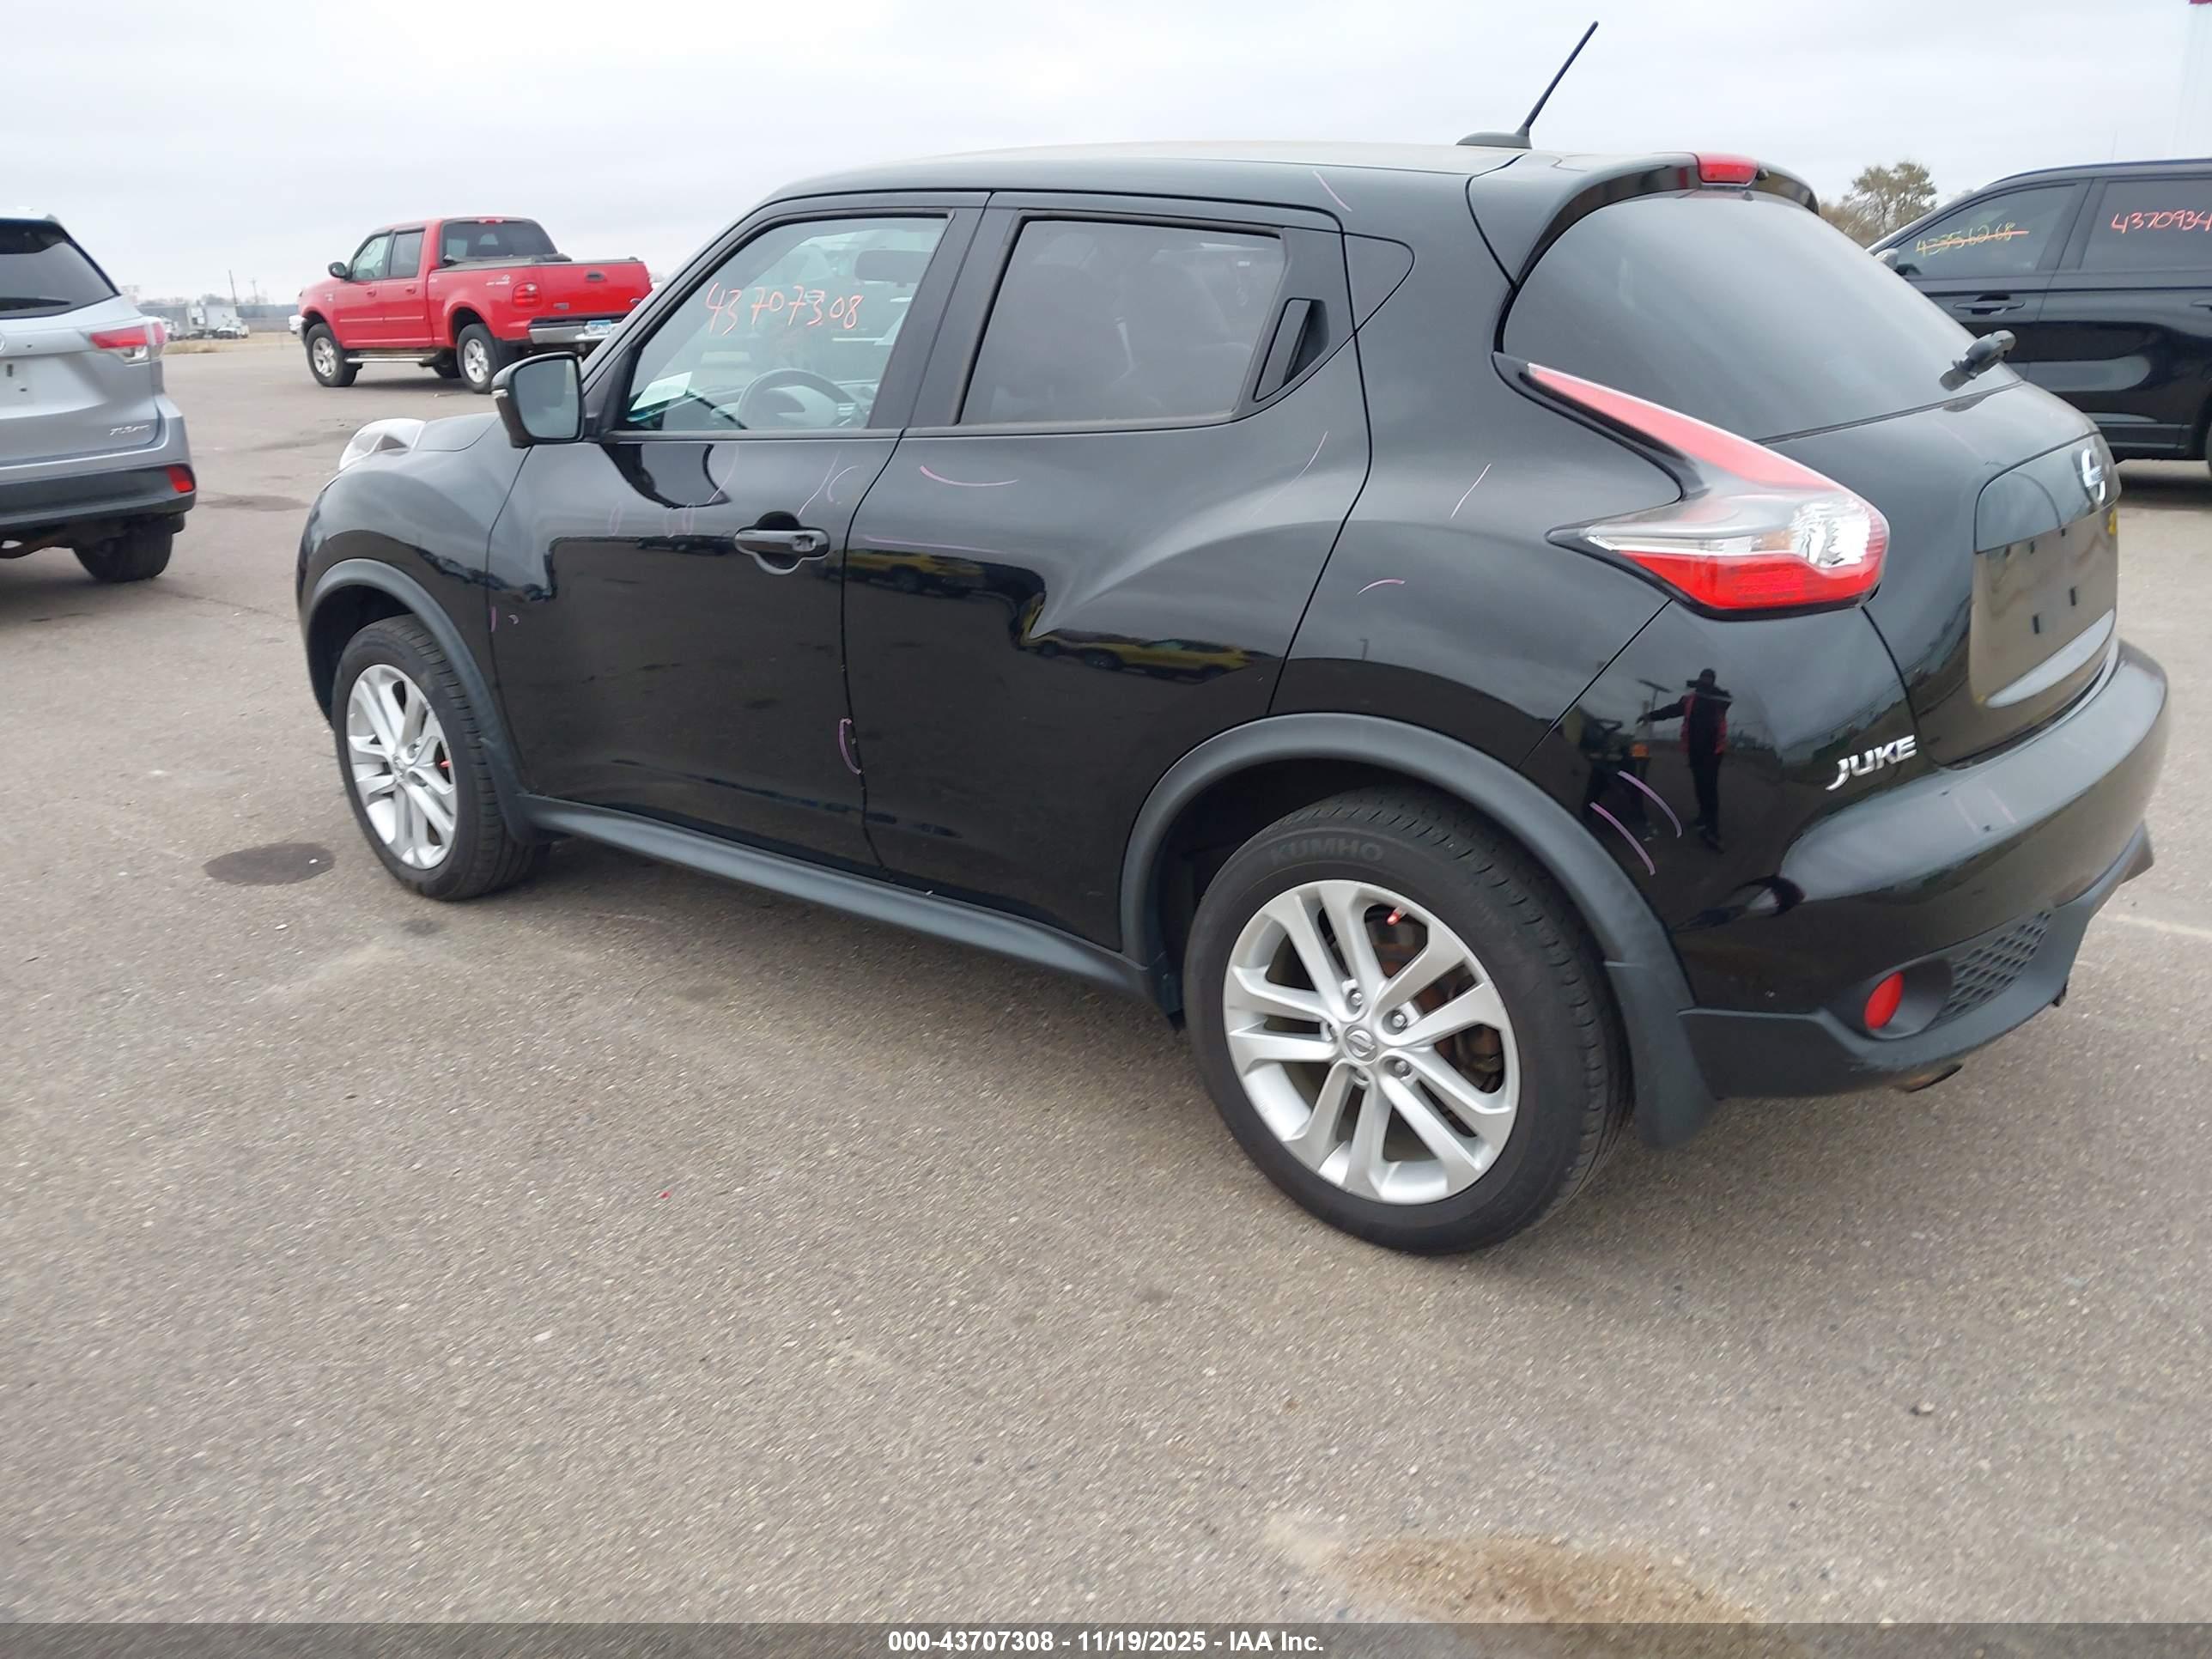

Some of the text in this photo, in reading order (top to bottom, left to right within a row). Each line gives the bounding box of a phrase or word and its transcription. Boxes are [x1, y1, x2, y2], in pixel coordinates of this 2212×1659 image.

[706, 283, 865, 336] 43707308
[1825, 734, 1917, 791] JUKE
[1270, 837, 1384, 866] KUMHO
